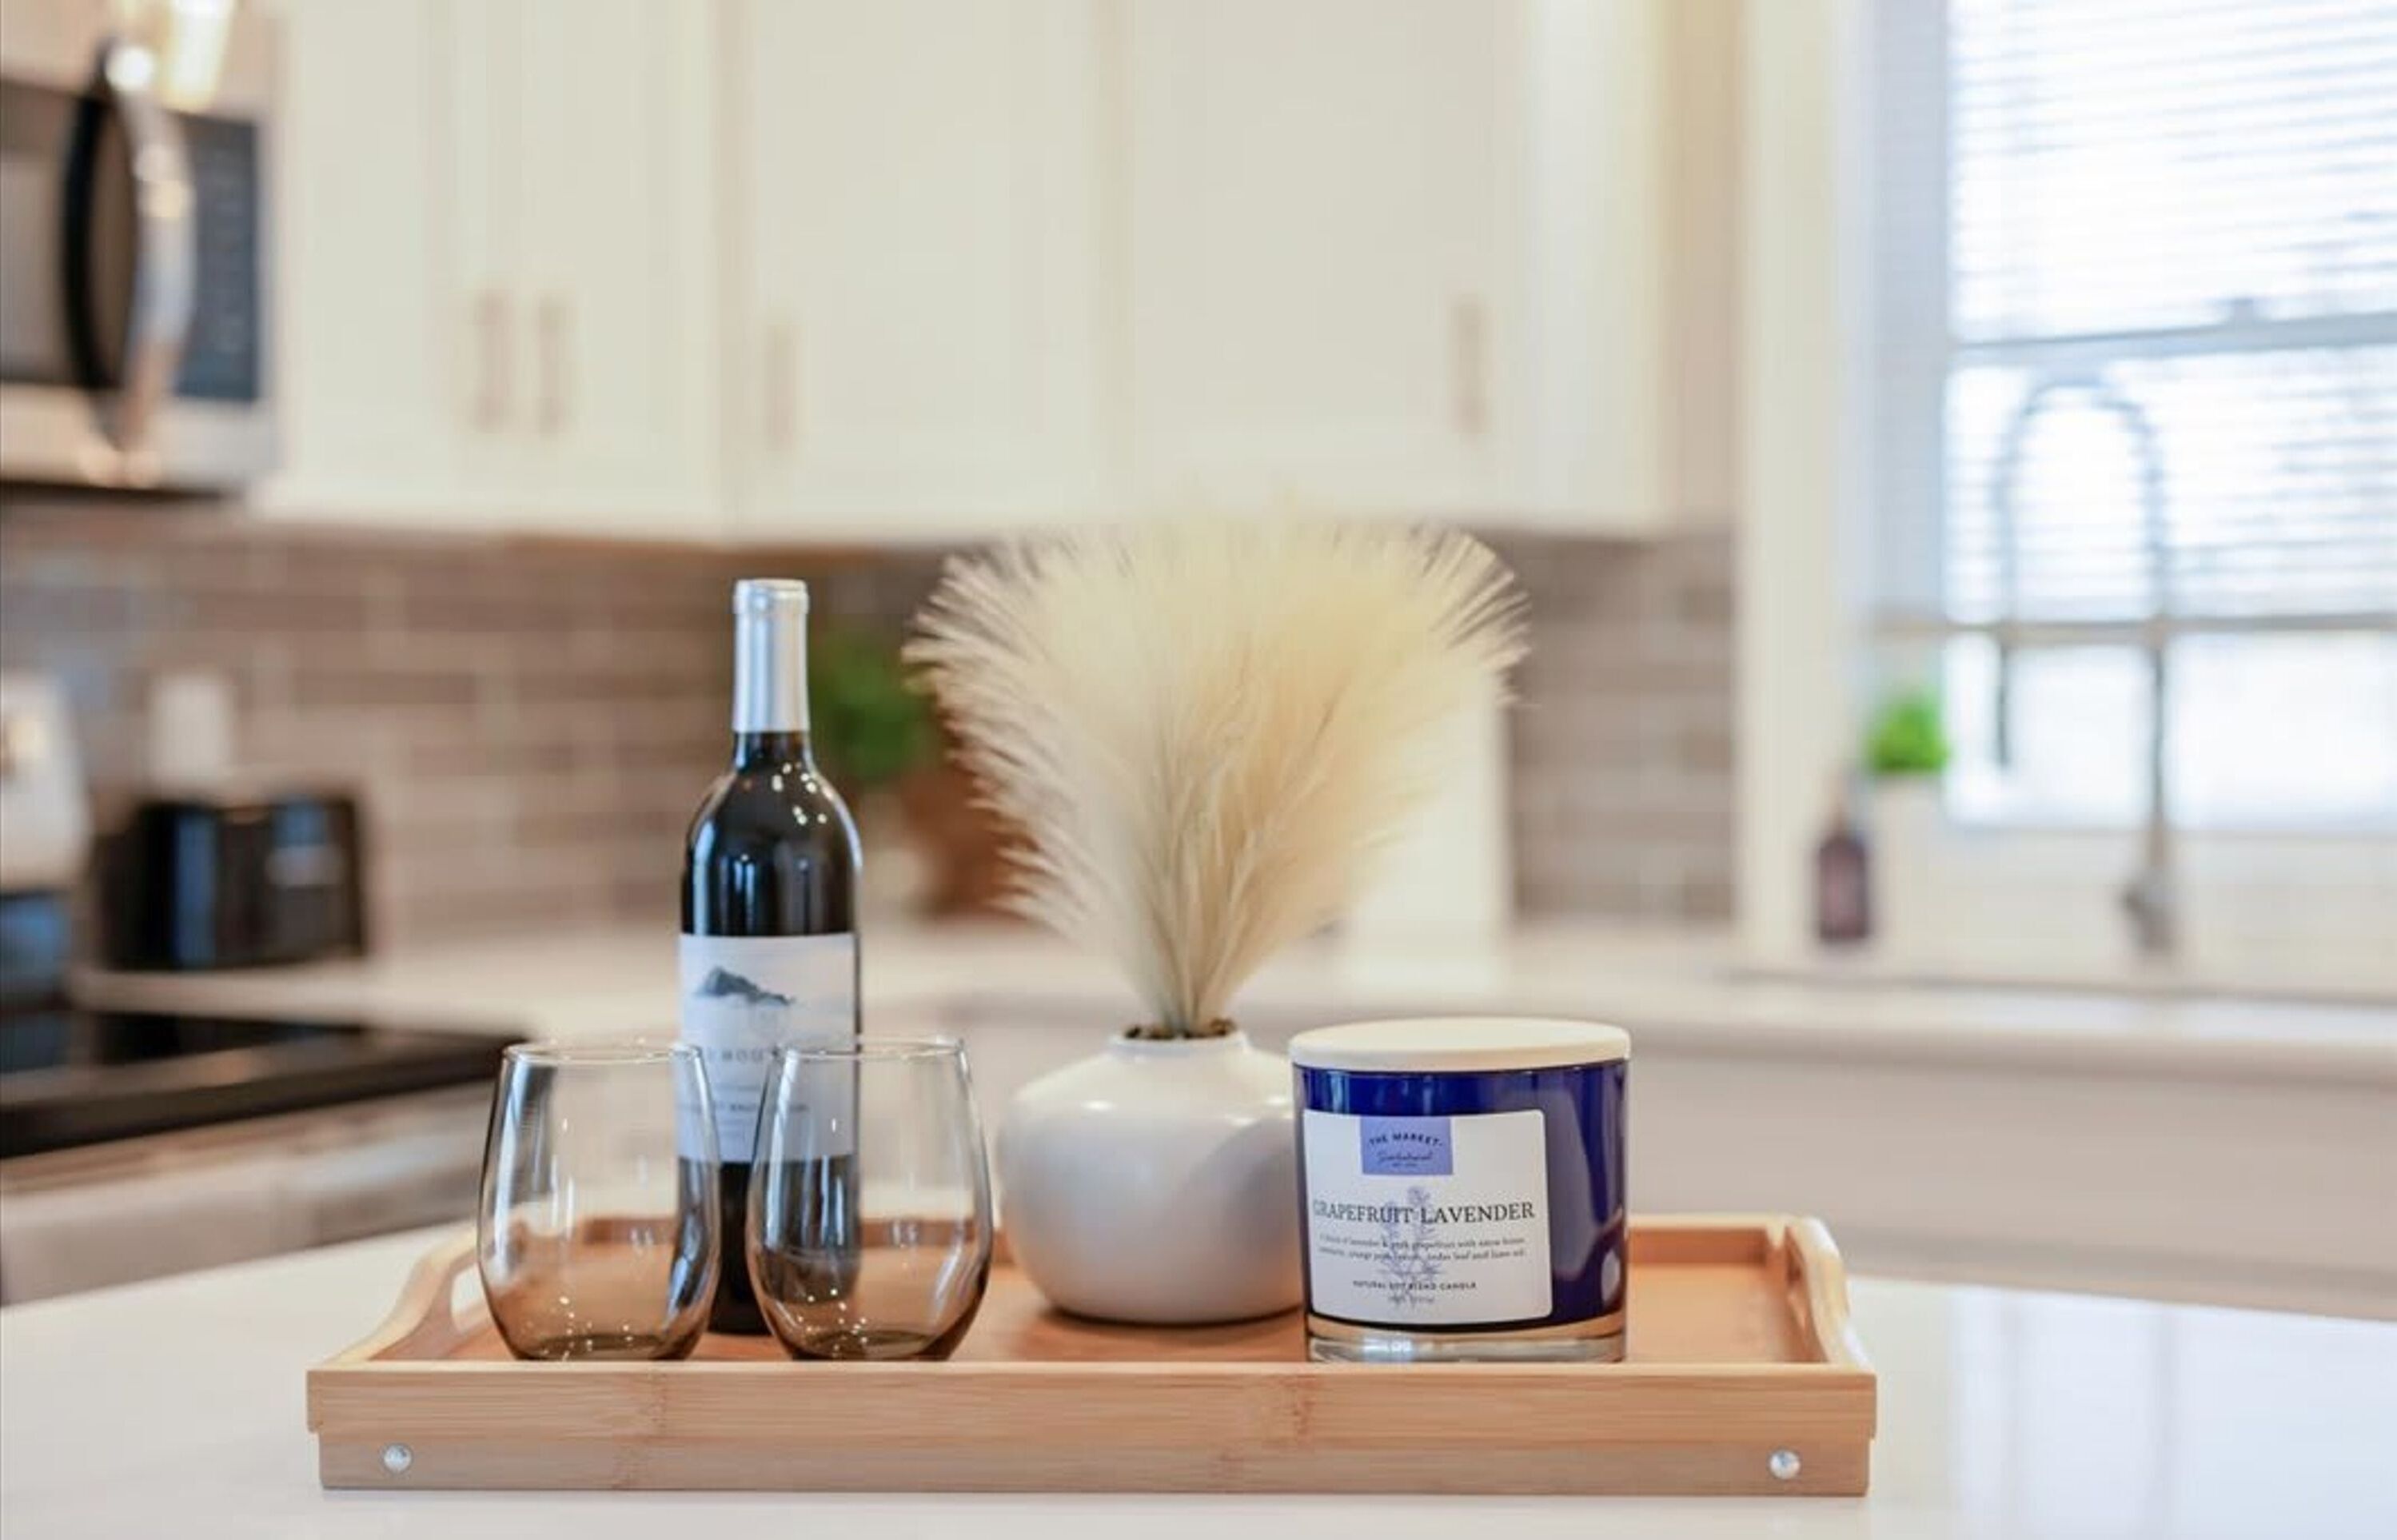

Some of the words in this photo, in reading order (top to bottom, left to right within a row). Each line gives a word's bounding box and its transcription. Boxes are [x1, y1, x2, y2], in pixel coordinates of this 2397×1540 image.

[1369, 1134, 1388, 1145] THE
[1313, 1199, 1414, 1223] GRAPEFRUIT
[1420, 1201, 1535, 1224] LAVENDER
[1439, 1281, 1477, 1291] CANDLE
